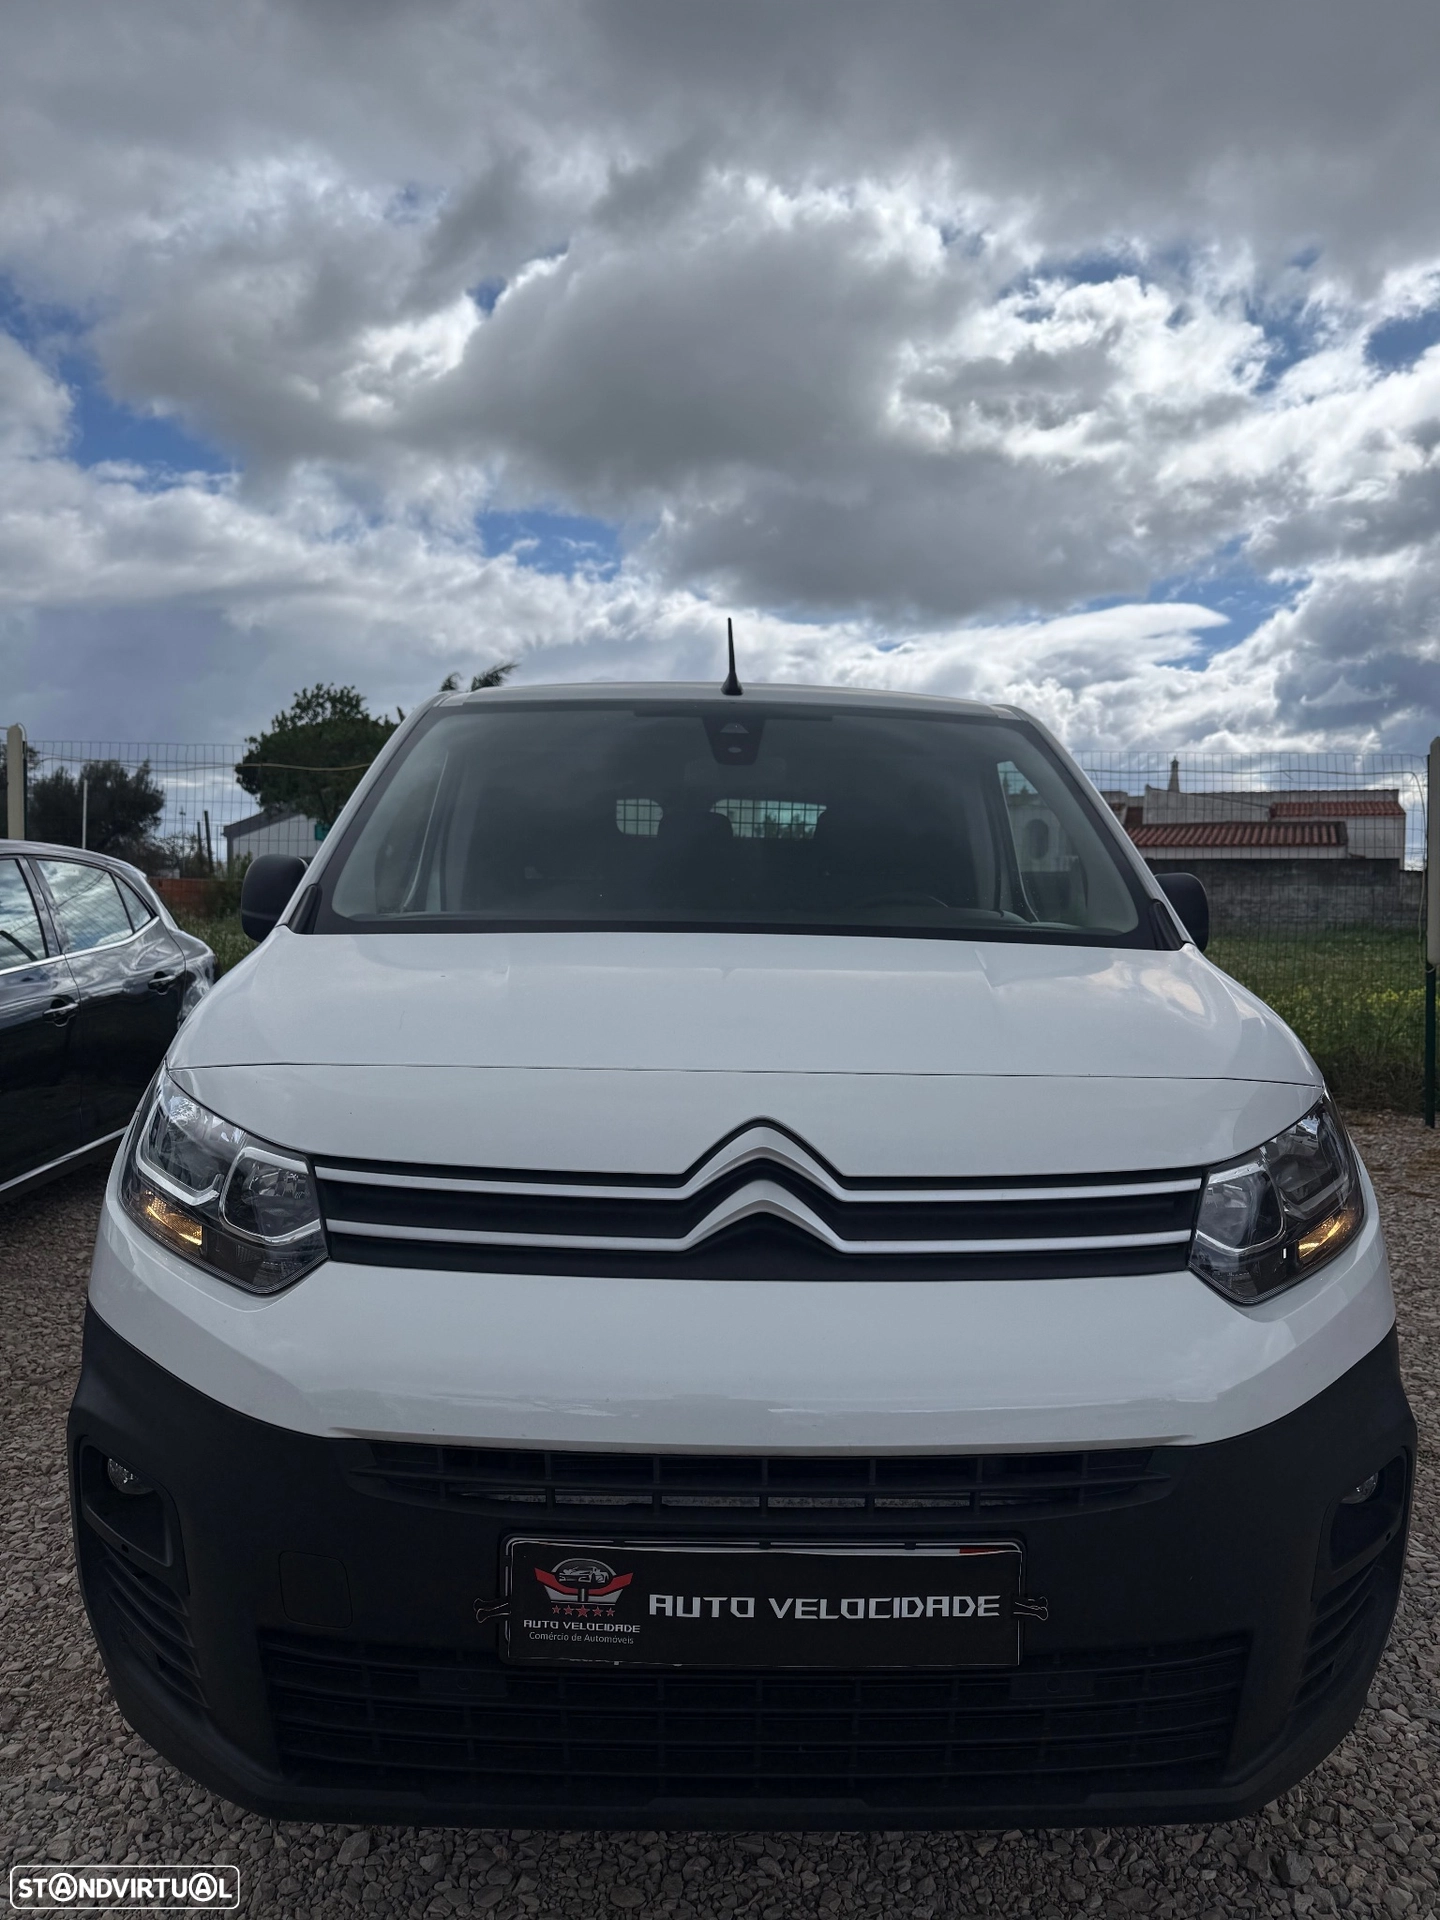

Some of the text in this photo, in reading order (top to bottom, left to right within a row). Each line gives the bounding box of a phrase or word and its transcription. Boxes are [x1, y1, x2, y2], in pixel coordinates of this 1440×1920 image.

[649, 1594, 1001, 1620] AUTO VELOCIDADE
[523, 1619, 641, 1633] AUTO VELOCIDADE
[529, 1631, 634, 1645] Comércio de Automóveis
